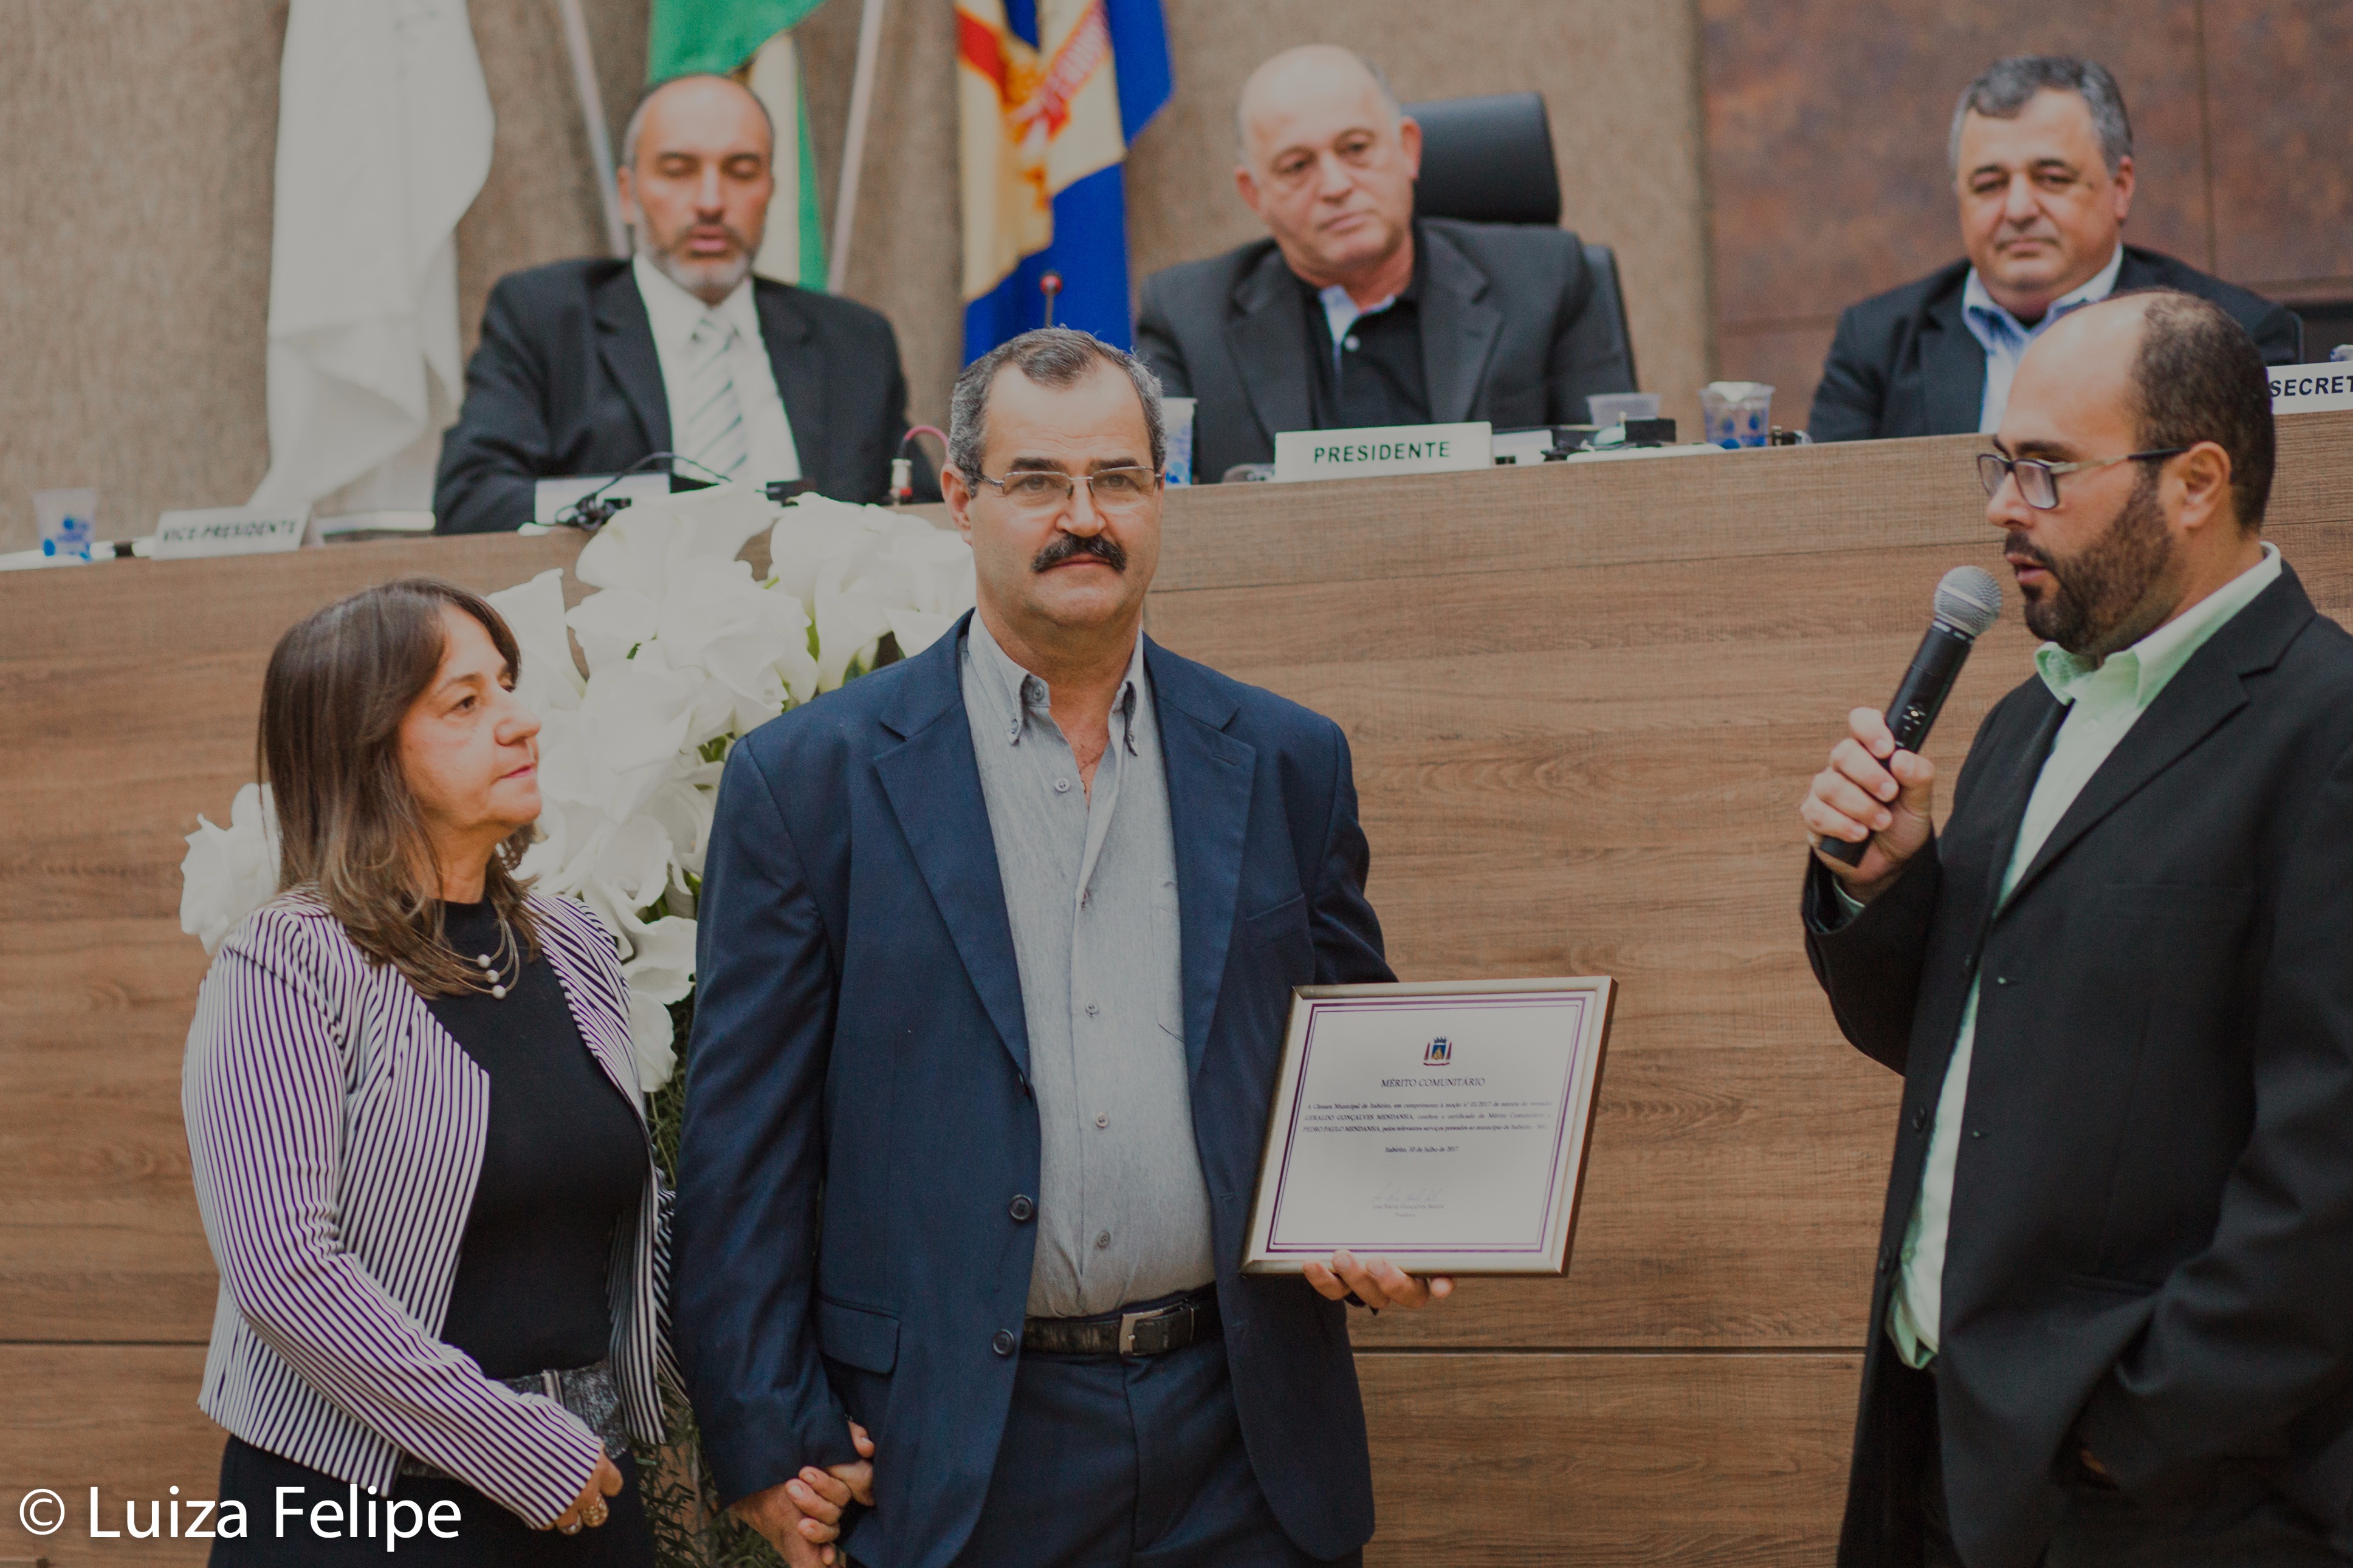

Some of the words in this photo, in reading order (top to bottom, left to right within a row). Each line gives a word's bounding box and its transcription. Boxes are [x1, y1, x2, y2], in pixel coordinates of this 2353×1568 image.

[1314, 441, 1450, 464] PRESIDENTE
[1381, 1078, 1417, 1087] MÉRITO
[1418, 1077, 1485, 1087] COMUNITÁRIO
